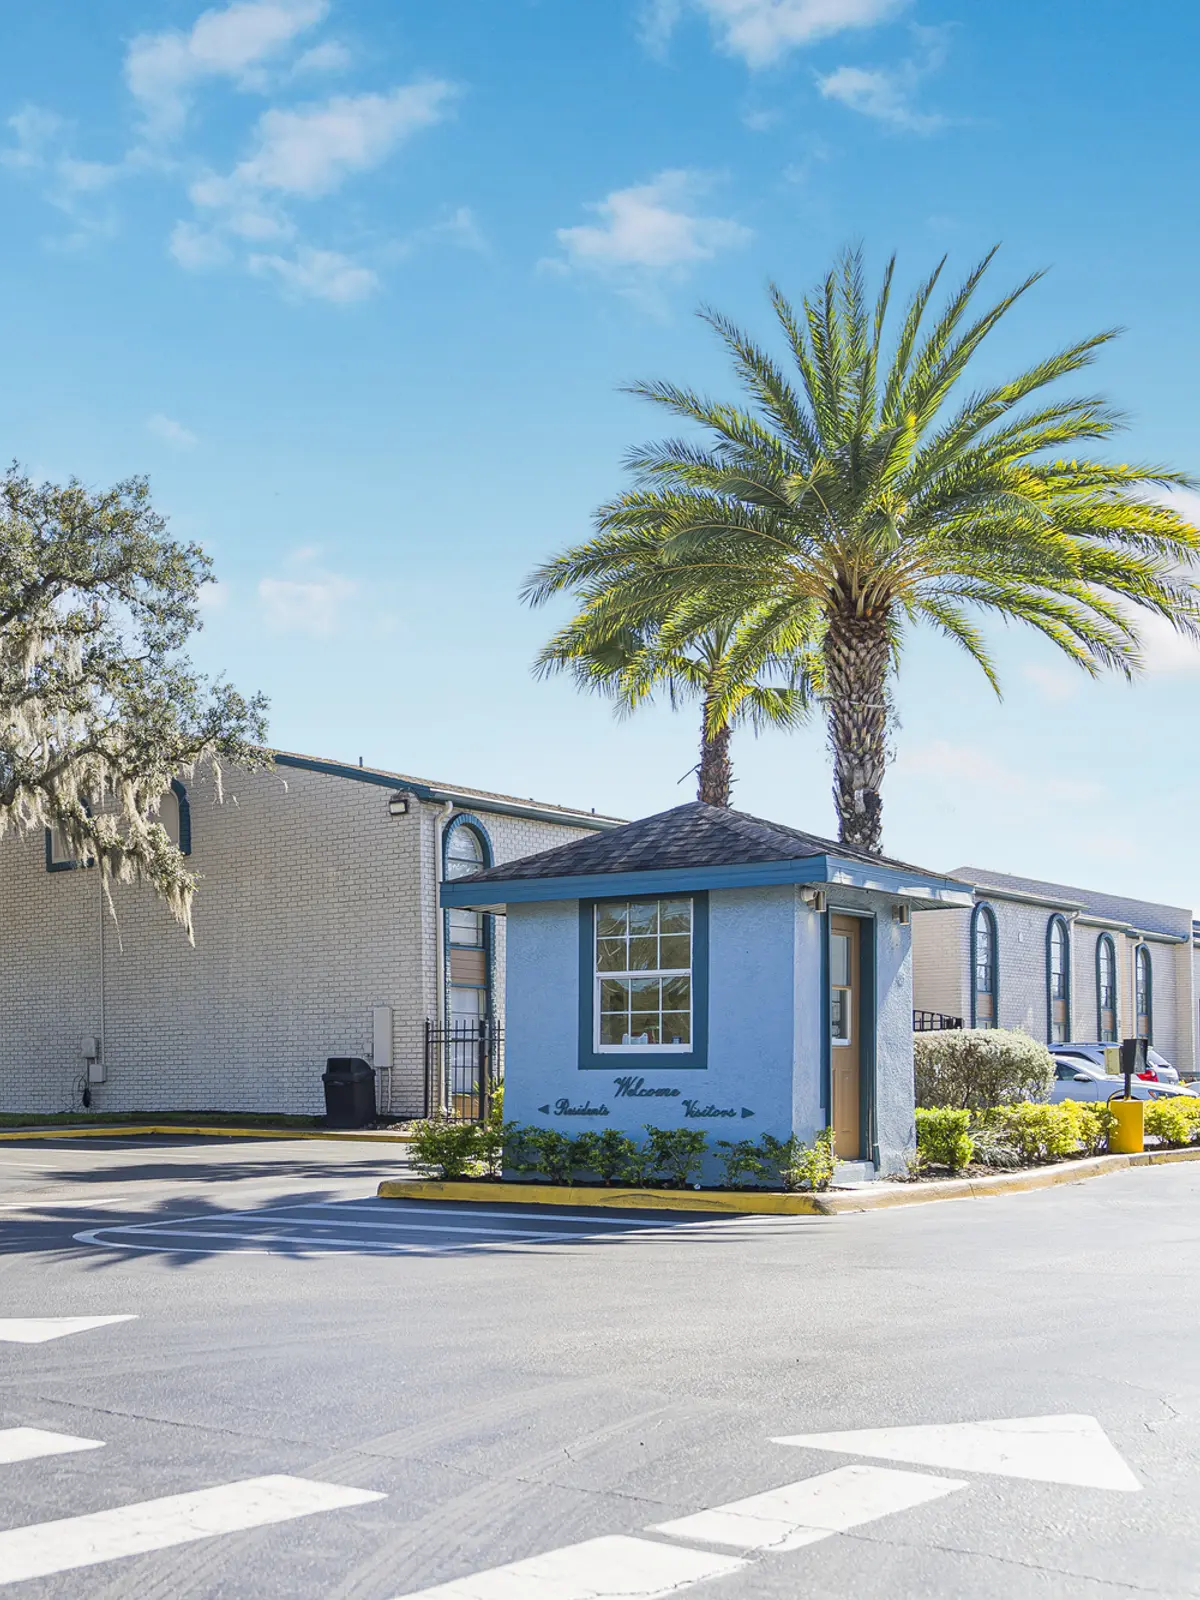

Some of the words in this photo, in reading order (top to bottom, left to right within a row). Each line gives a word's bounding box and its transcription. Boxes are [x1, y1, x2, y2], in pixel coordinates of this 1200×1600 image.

[613, 1076, 681, 1098] Welcome
[553, 1098, 610, 1117] Residents
[681, 1099, 737, 1118] Visitors
